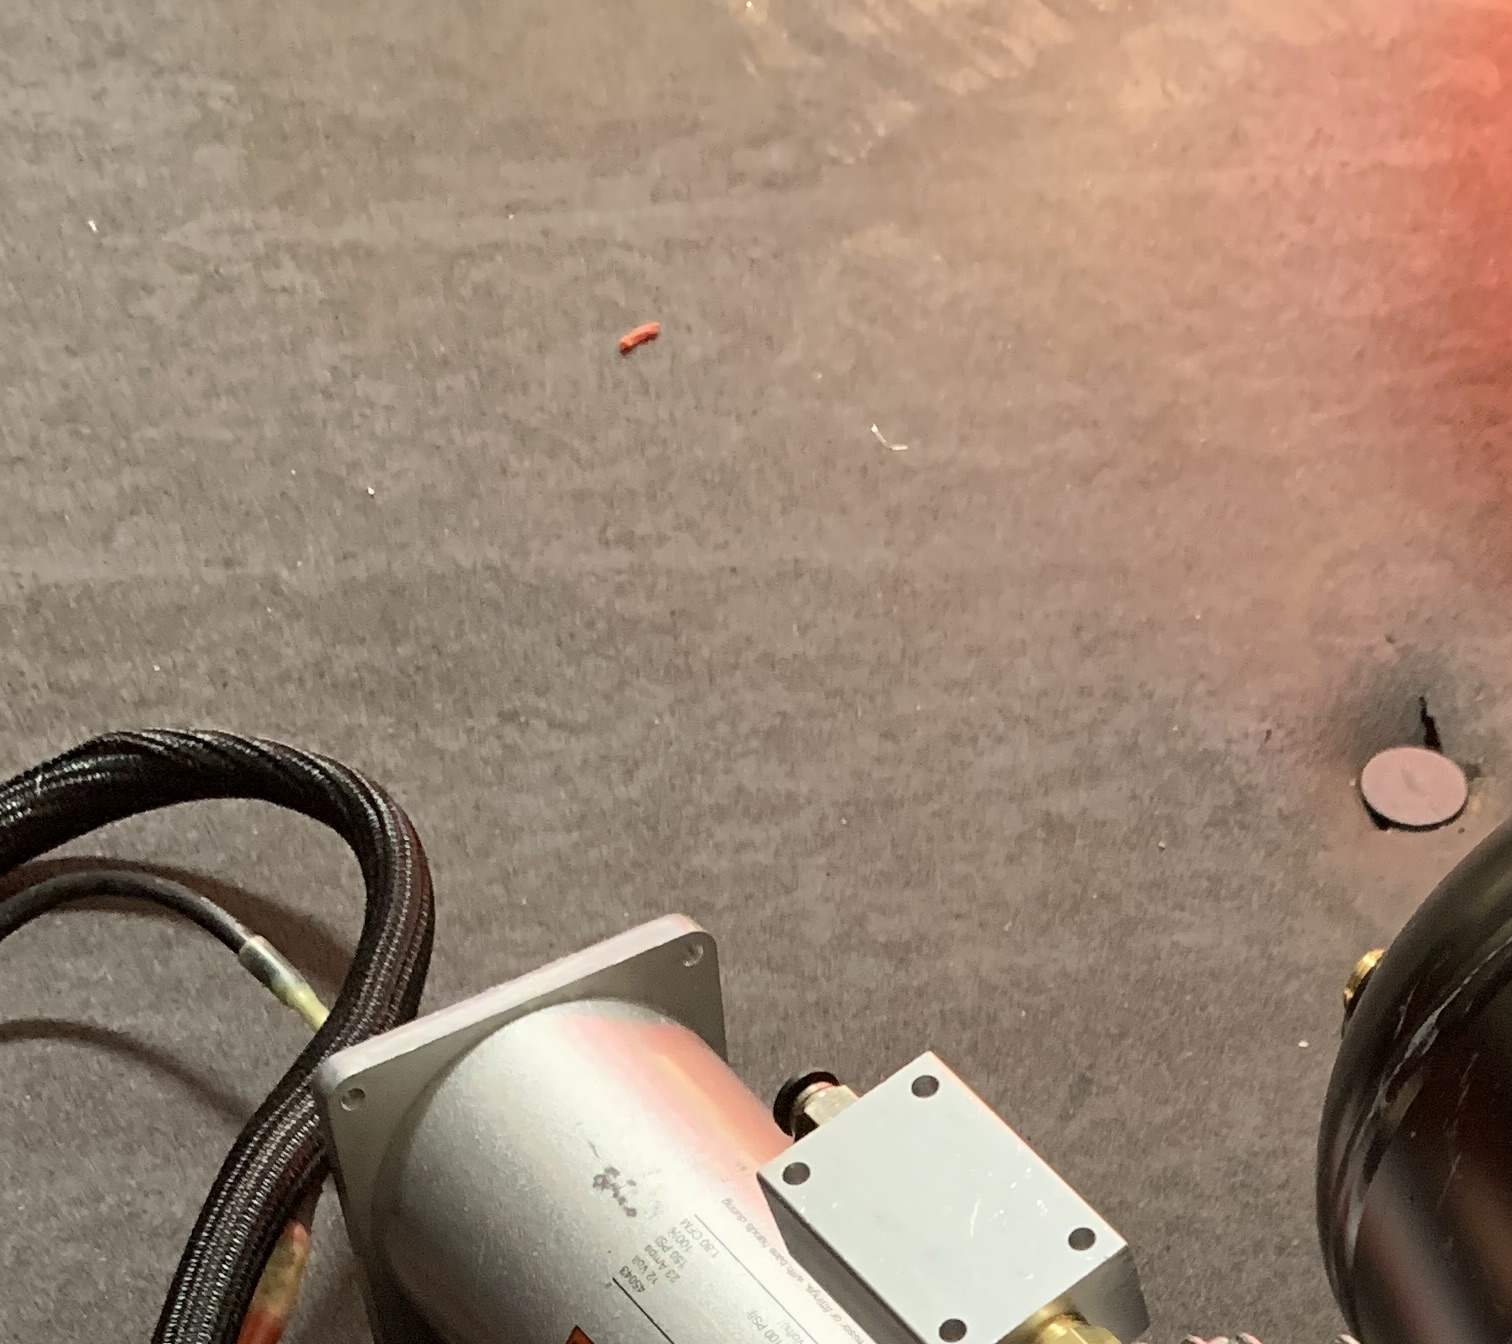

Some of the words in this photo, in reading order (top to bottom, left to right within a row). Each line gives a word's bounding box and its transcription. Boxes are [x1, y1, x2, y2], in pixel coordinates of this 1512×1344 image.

[618, 1265, 646, 1294] 45043
[646, 1271, 659, 1284] 12
[665, 1268, 680, 1283] 23
